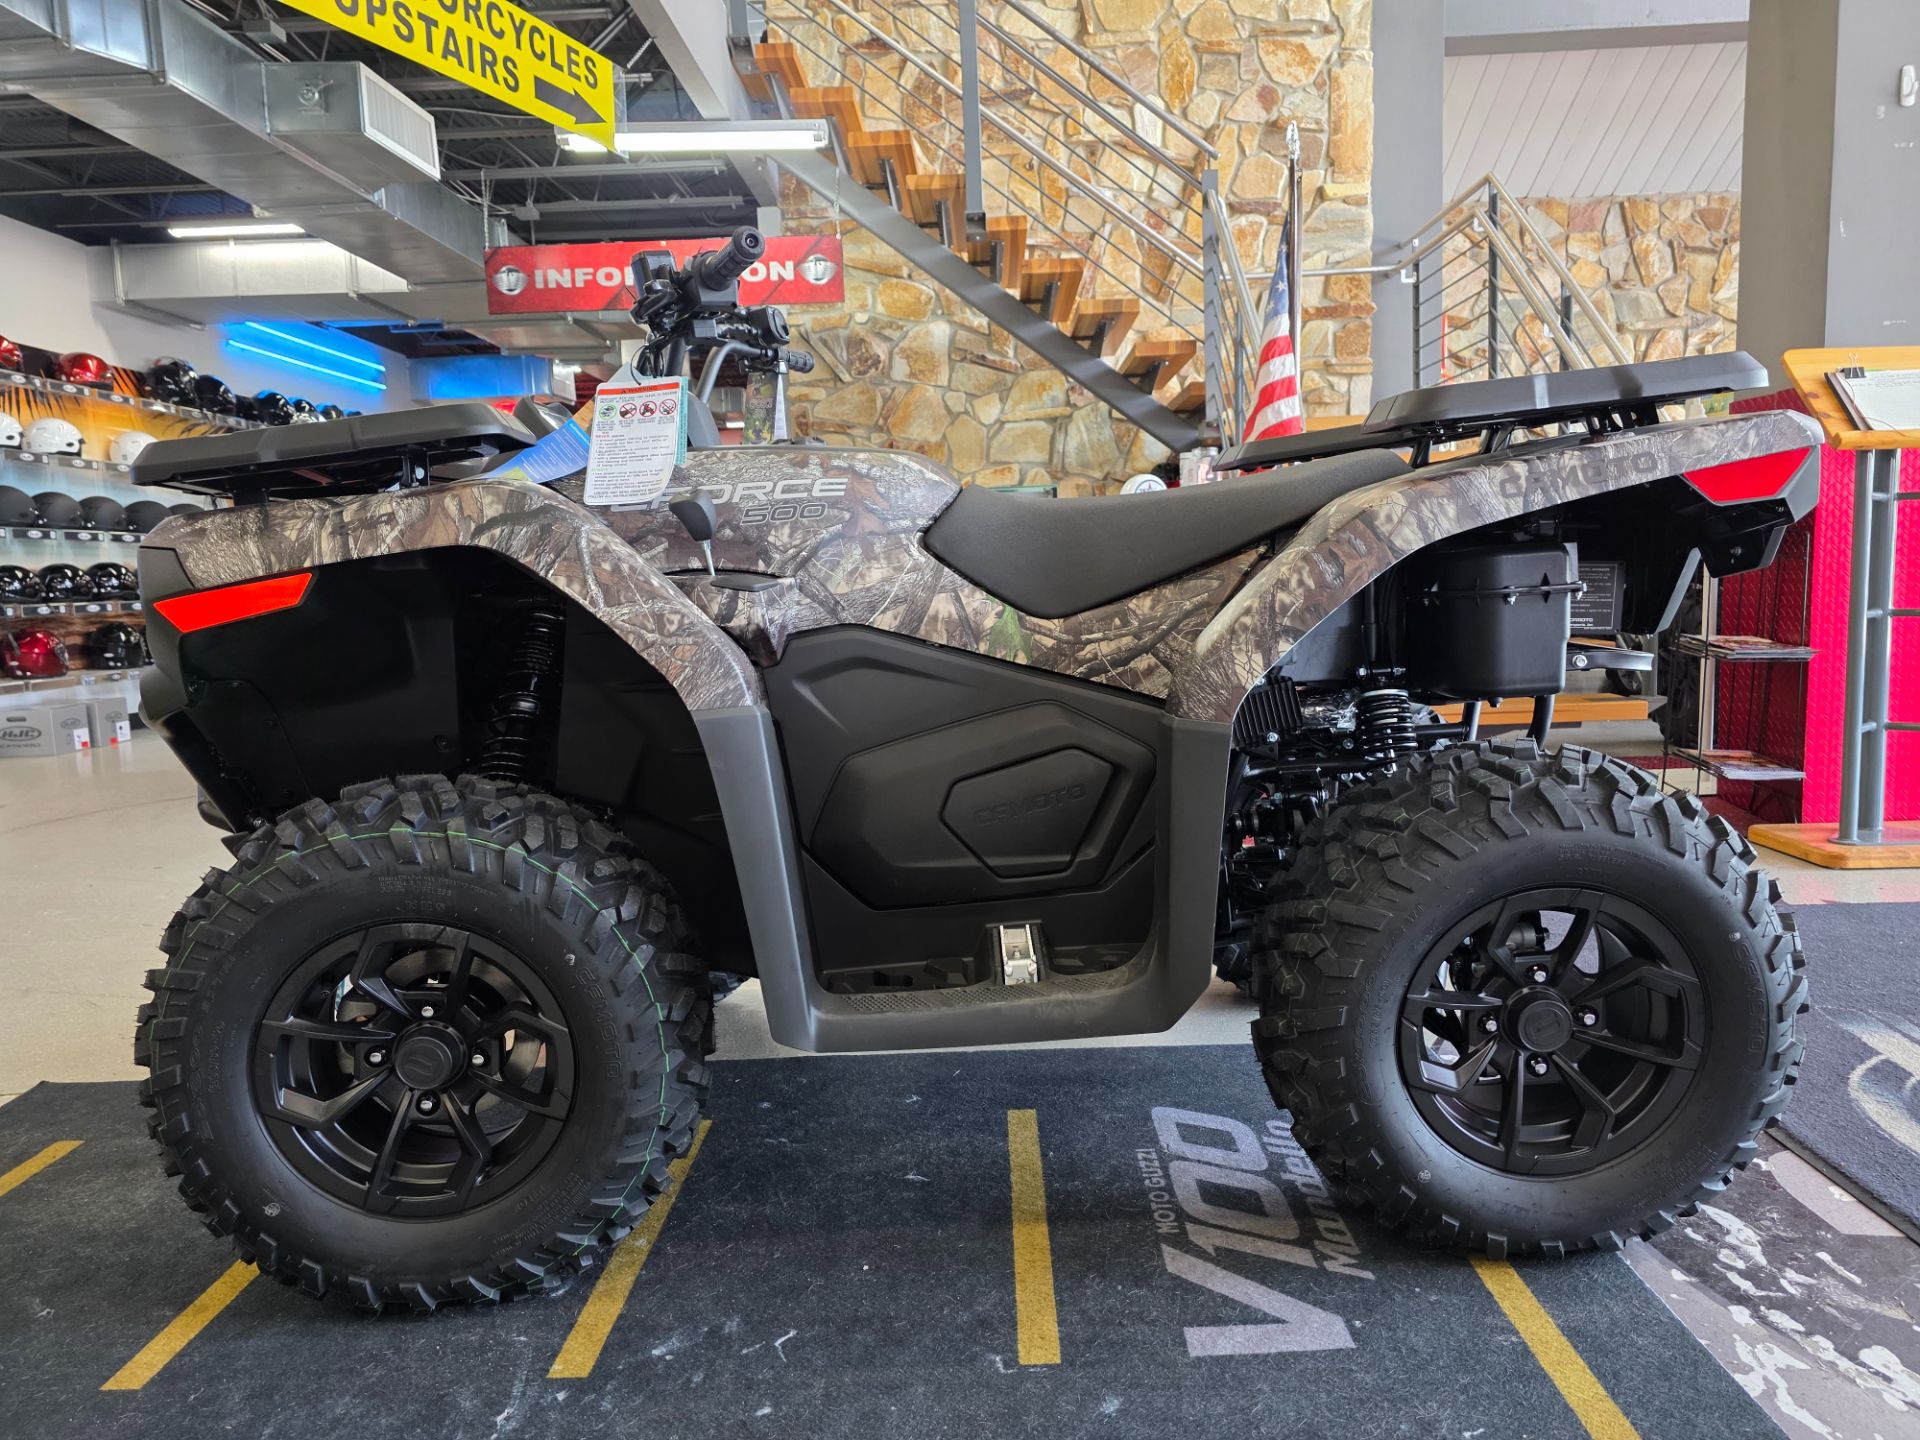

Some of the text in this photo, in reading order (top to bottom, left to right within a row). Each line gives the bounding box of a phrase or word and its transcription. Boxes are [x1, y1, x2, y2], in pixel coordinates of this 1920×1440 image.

[1499, 451, 1658, 500] CFMOTO
[740, 502, 828, 526] 500
[972, 782, 1087, 827] CFMOTO
[1137, 1148, 1180, 1234] MOTO GUZZI
[1151, 1106, 1358, 1358] V100
